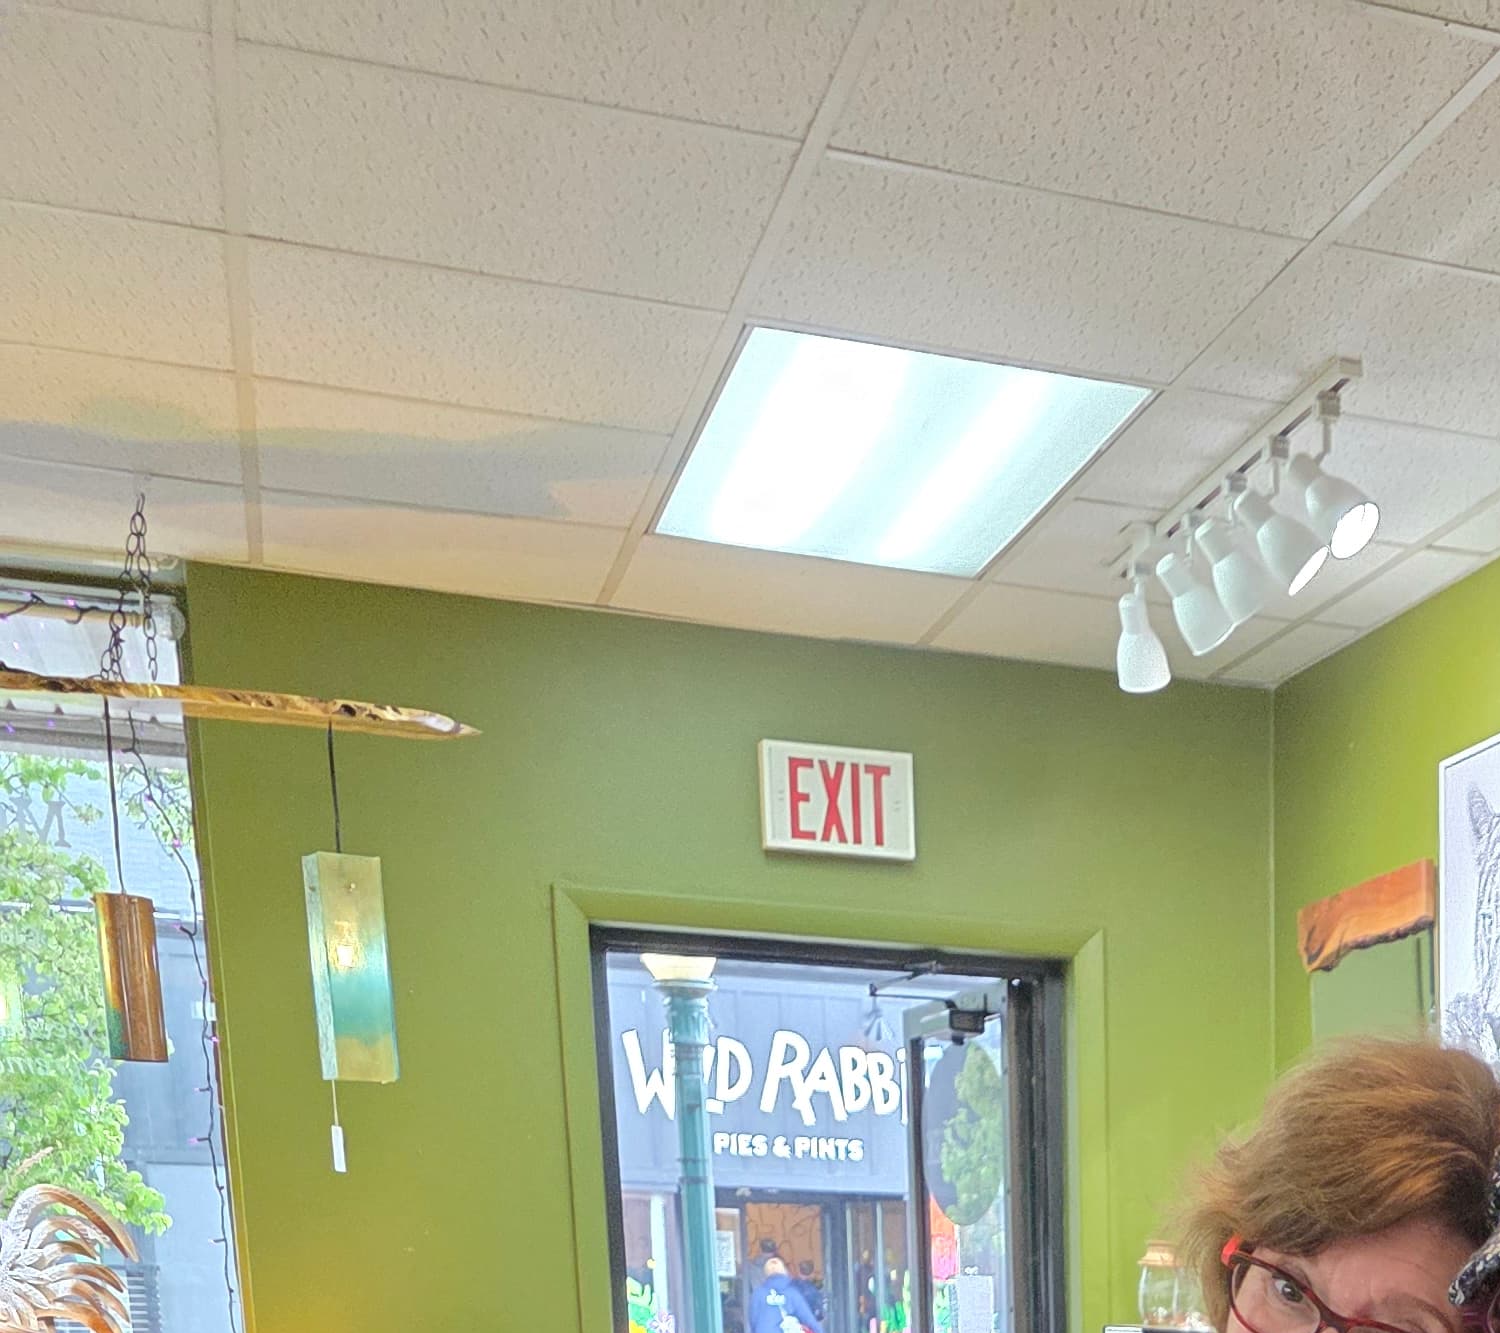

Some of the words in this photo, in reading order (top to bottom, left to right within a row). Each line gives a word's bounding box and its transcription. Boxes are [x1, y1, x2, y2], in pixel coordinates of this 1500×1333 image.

[788, 756, 890, 846] EXIT
[621, 1028, 753, 1120] WLD
[713, 1132, 767, 1157] PIES
[772, 1136, 792, 1160] &
[794, 1136, 864, 1162] PINTS
